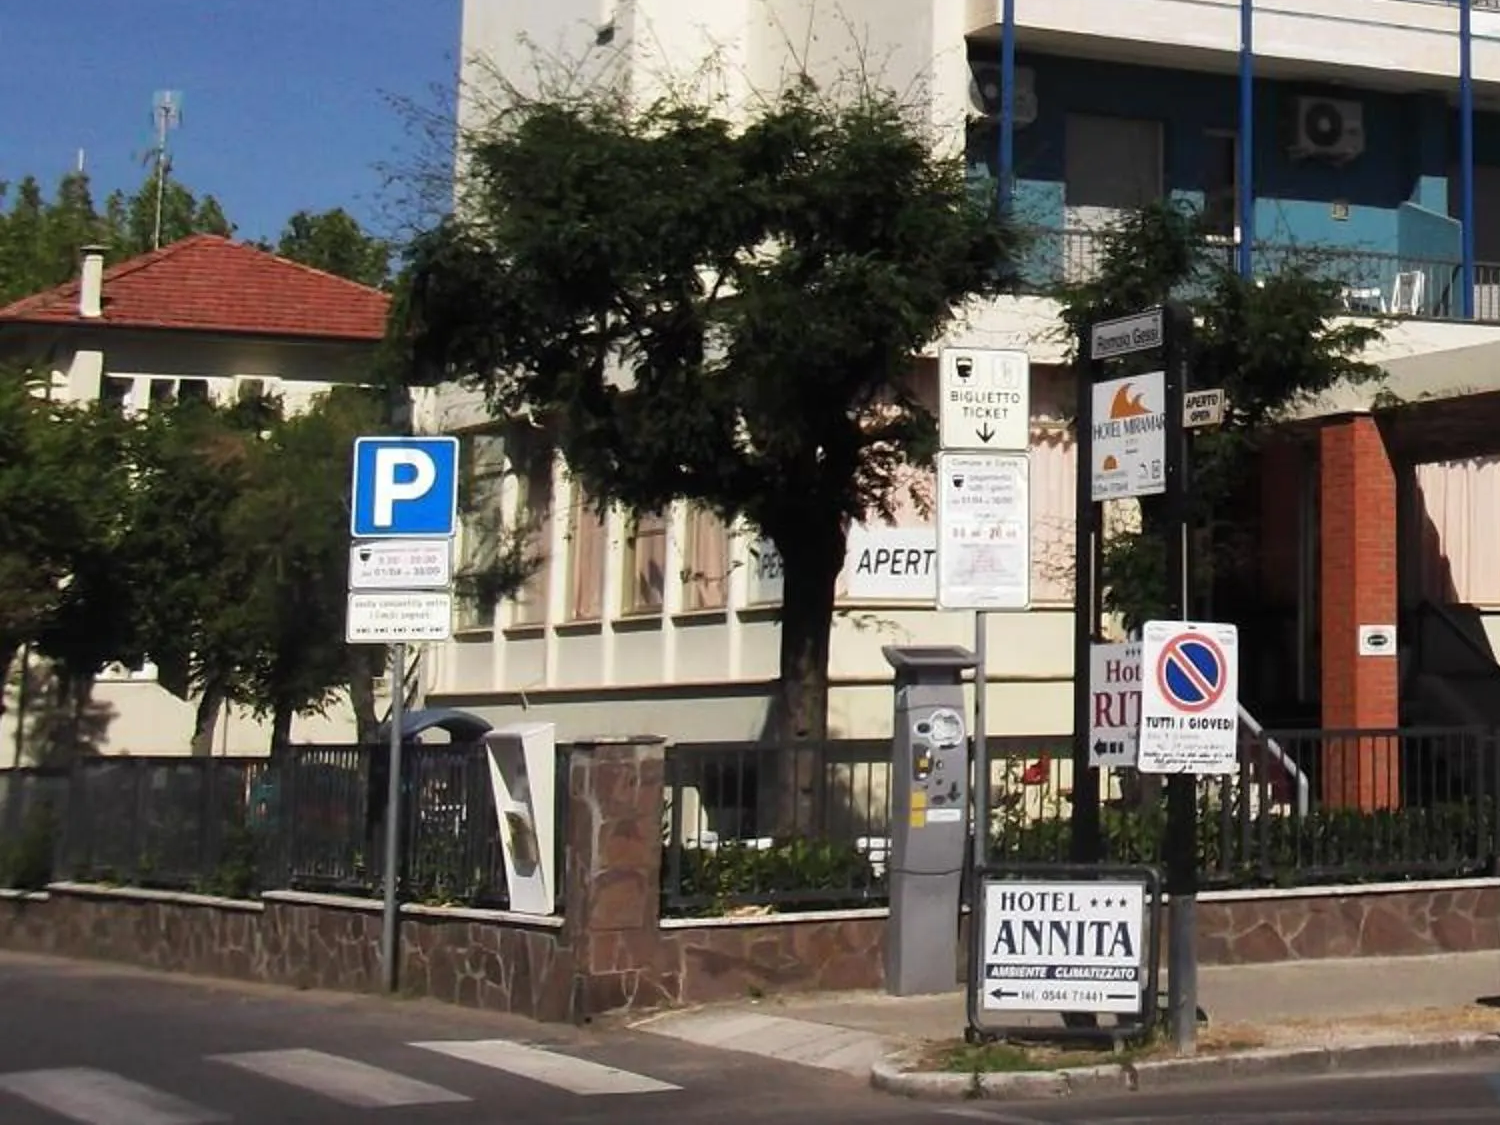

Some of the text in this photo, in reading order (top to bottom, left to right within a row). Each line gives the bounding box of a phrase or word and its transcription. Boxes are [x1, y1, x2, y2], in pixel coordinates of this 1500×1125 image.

[950, 390, 1021, 404] BIGLIETTO
[1186, 394, 1218, 410] APERTO
[962, 406, 1009, 420] TICKET
[1093, 421, 1121, 441] HOTEL
[373, 448, 436, 528] P
[856, 548, 937, 575] APERT
[1145, 716, 1175, 729] TUTTI
[1001, 892, 1080, 912] HOTEL
[992, 919, 1134, 957] ANNITA
[991, 966, 1135, 980] AMBIENTE CLIMATIZZATO
[1042, 990, 1067, 1001] 0544
